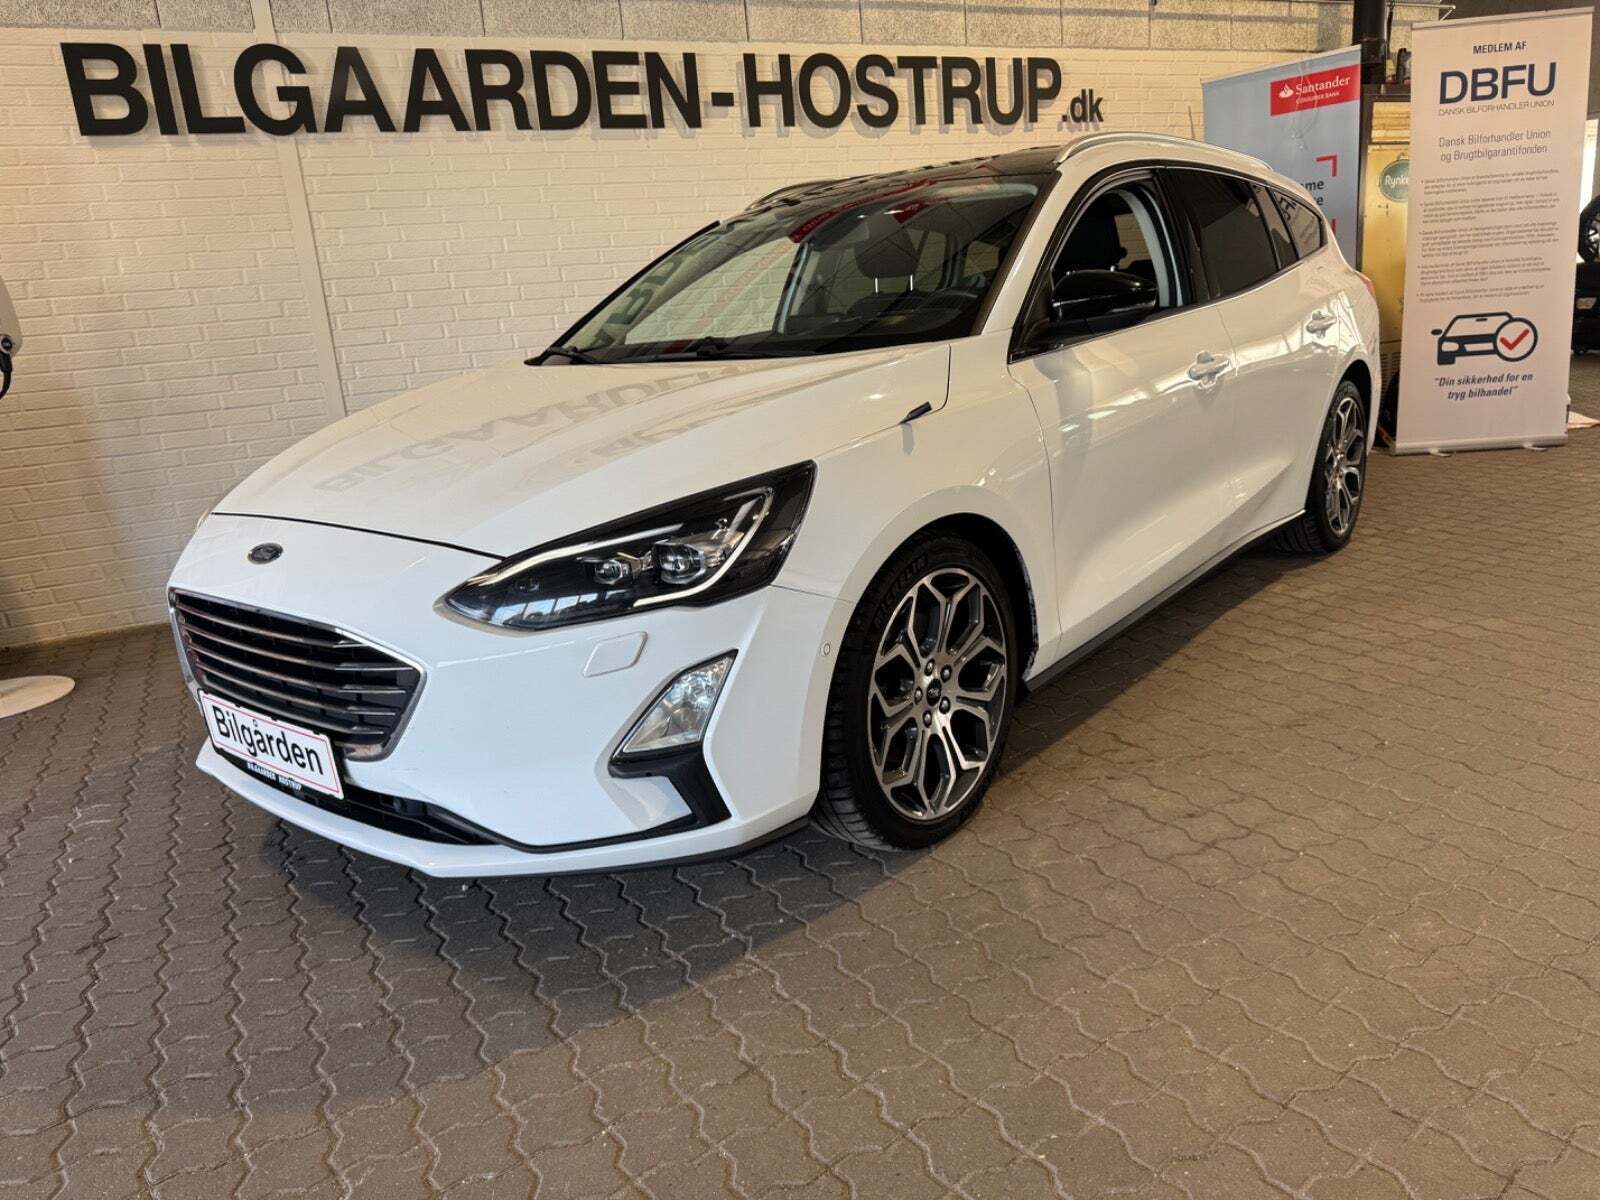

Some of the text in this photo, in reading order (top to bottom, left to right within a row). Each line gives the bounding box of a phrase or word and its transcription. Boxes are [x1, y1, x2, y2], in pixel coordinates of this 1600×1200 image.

[1473, 41, 1527, 54] MEDLEM AF
[1295, 75, 1351, 95] Santander
[1440, 62, 1556, 104] DBFU
[1325, 91, 1340, 100] BANK
[1438, 108, 1464, 117] DANSK
[1530, 100, 1555, 108] UNION
[1439, 129, 1551, 148] Dansk Bilforhandler Union
[1440, 145, 1548, 163] og Brugtbilgarantifonden
[1457, 373, 1504, 385] sikkerhed
[1506, 372, 1519, 382] for
[1521, 373, 1533, 381] en
[1447, 390, 1466, 401] tryg
[212, 703, 325, 776] Bilgården
